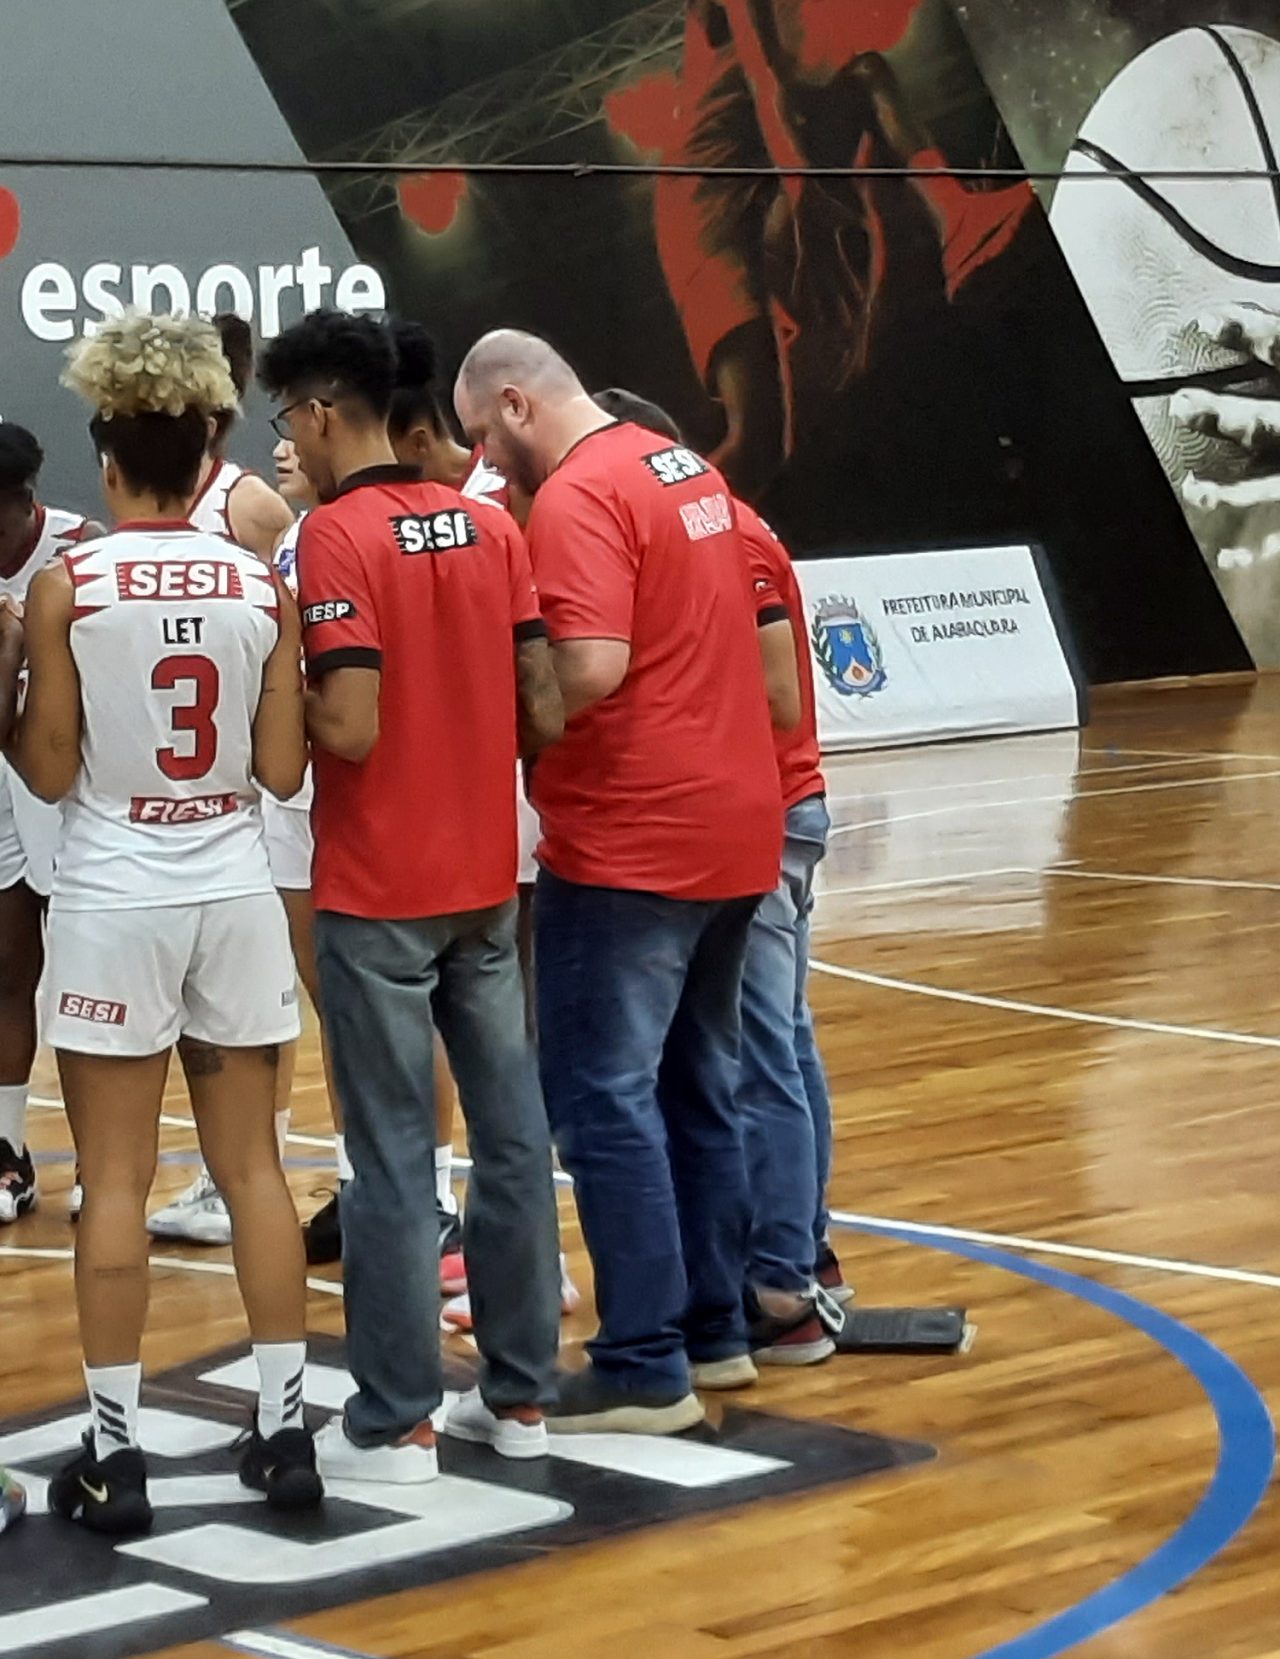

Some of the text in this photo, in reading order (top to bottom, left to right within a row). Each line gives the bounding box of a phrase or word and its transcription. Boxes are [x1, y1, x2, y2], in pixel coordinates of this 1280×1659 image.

[129, 563, 228, 596] SESI
[163, 617, 205, 644] LET
[151, 654, 219, 781] 3
[64, 996, 119, 1022] SESI
